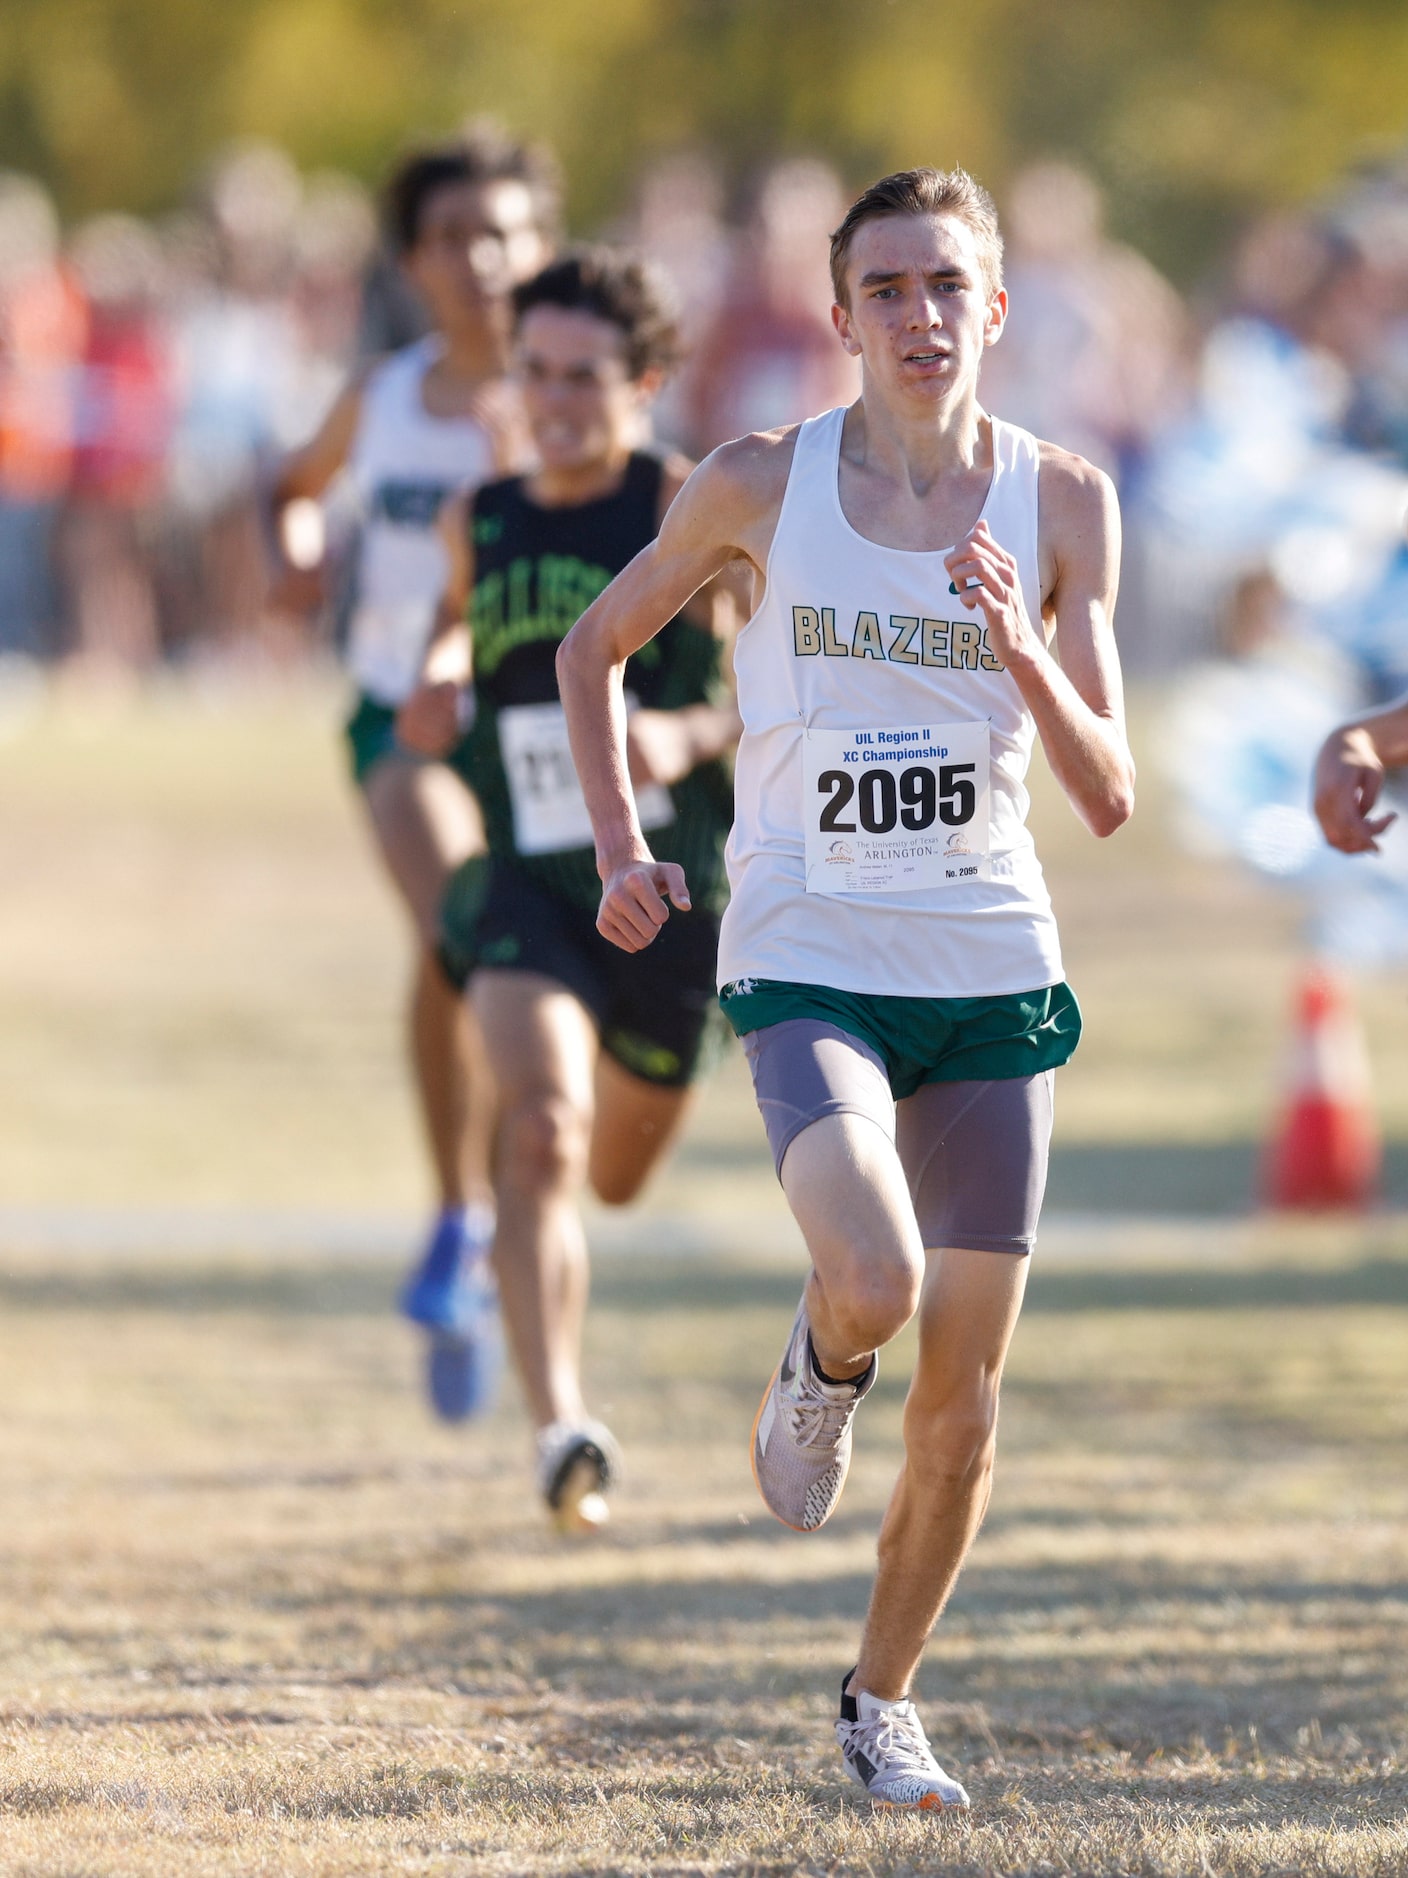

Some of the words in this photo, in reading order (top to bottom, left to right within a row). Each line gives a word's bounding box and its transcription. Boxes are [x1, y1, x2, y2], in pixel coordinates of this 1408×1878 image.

[792, 605, 1006, 672] BLAZERS
[855, 733, 874, 745] UIL
[878, 730, 919, 745] Region
[922, 729, 931, 741] II
[843, 751, 859, 763] XC
[862, 746, 949, 763] Championship
[817, 763, 976, 834] 2095
[872, 840, 908, 849] University
[910, 837, 918, 846] of
[920, 836, 939, 845] Texas
[864, 846, 933, 860] ARLINGTON
[945, 869, 958, 879] No.
[959, 866, 978, 877] 2095
